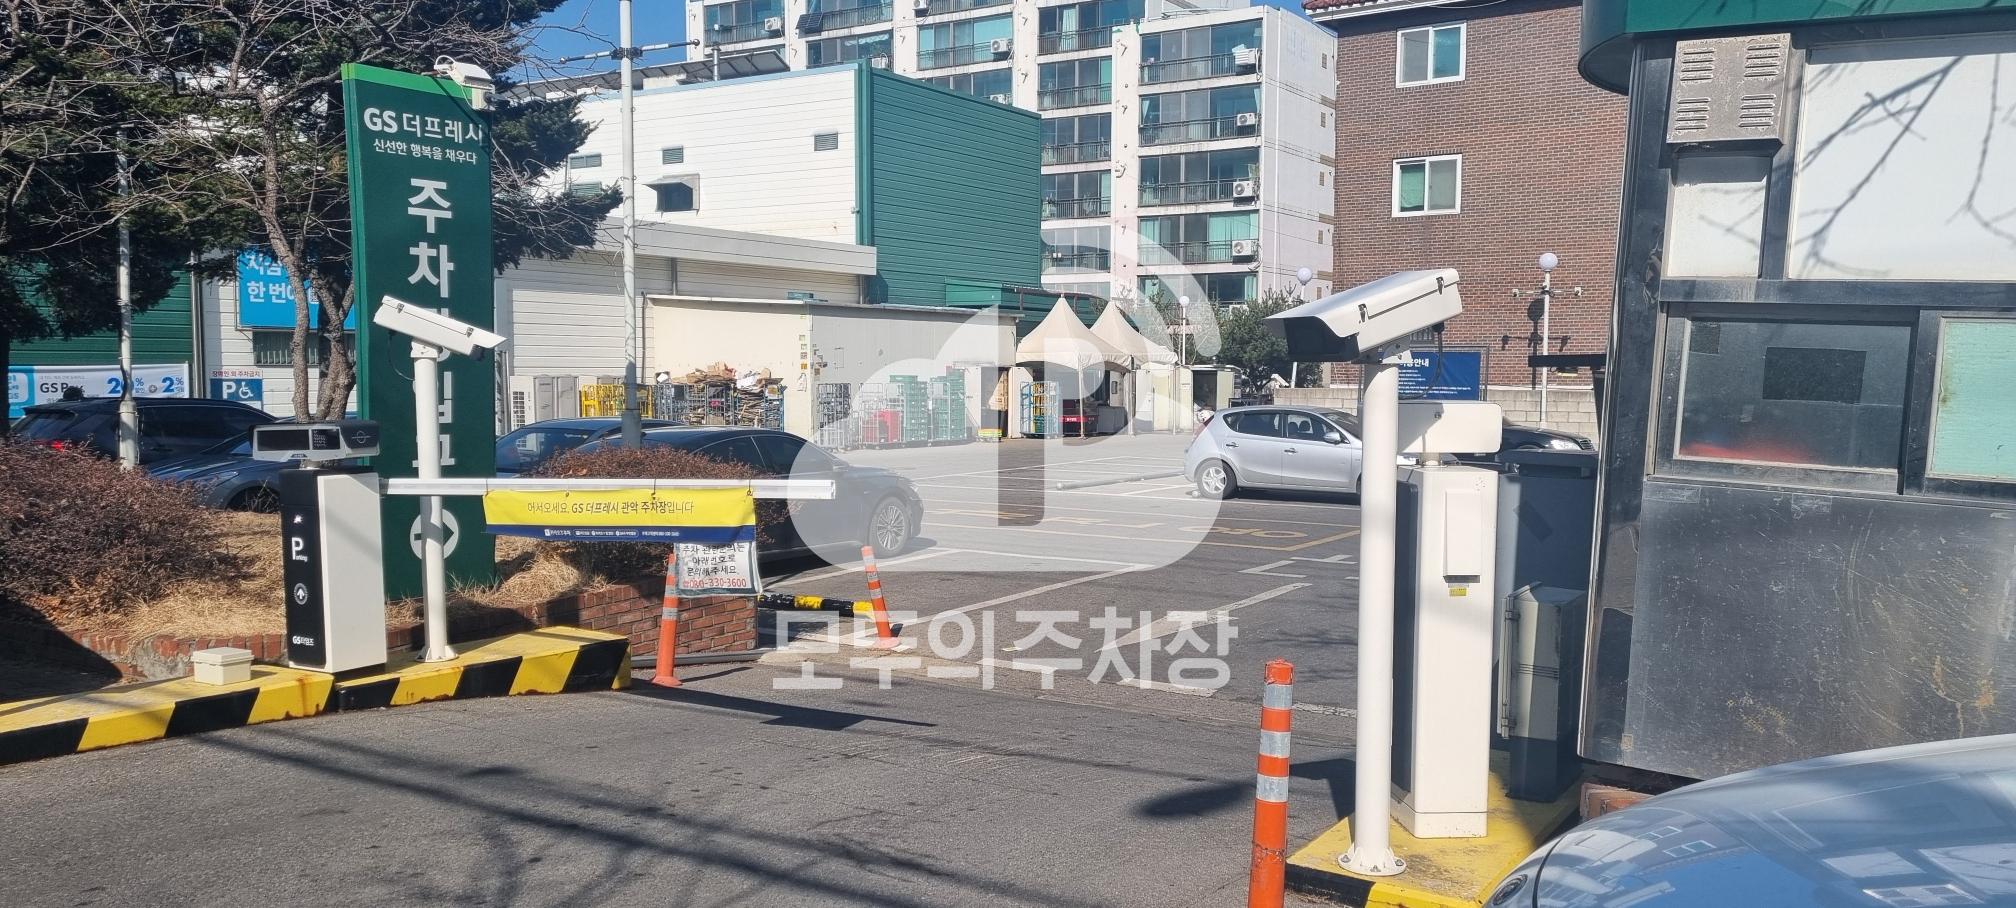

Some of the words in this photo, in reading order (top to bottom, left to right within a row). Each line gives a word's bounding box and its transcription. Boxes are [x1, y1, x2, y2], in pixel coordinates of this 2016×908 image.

[373, 138, 407, 156] 신선한
[410, 142, 443, 161] 행복을
[444, 147, 477, 165] 채우다
[246, 281, 266, 303] 한
[40, 383, 58, 394] GS
[222, 382, 236, 399] P
[571, 503, 584, 514] GS
[586, 502, 619, 515] 더프레시
[621, 502, 639, 515] 관악
[641, 501, 695, 515] 주차장입니다
